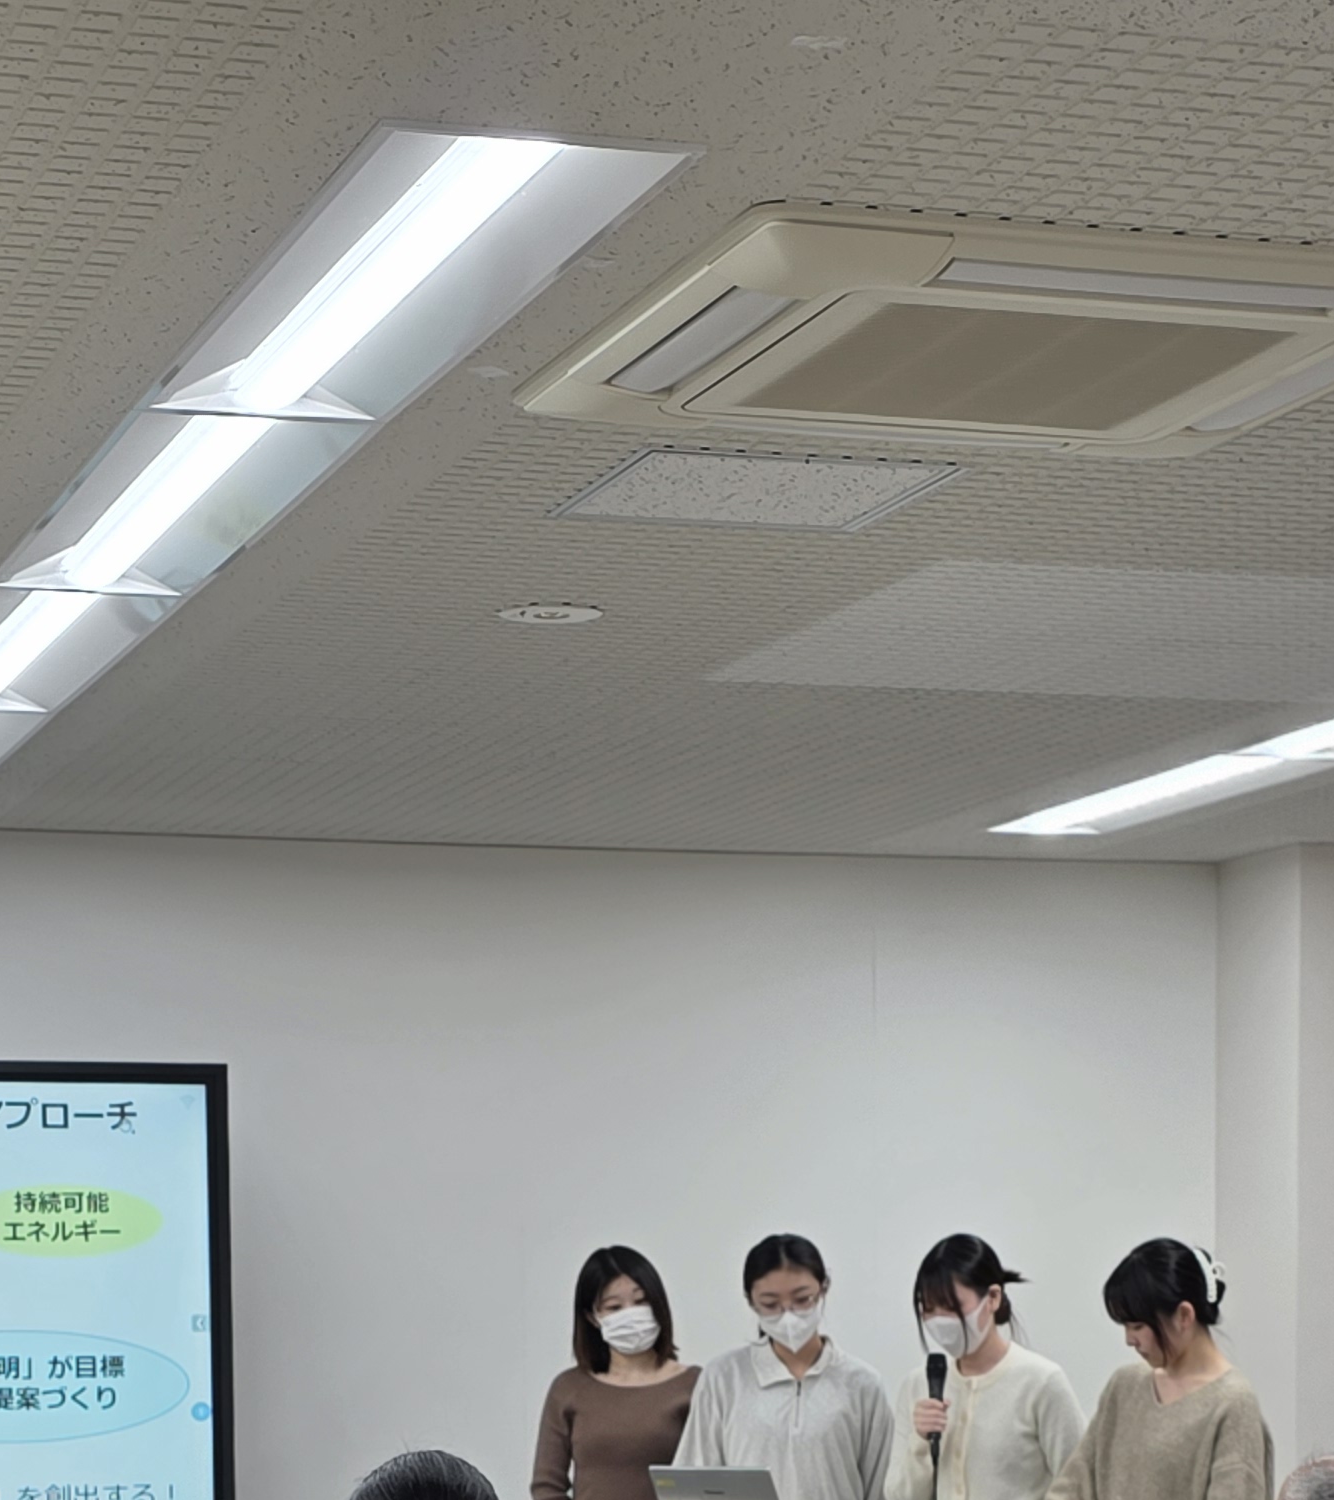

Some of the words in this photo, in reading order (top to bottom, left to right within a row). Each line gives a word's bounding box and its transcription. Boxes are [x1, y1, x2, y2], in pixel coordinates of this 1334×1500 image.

[14, 1191, 110, 1214] 持続可能
[3, 1219, 121, 1242] エネルギー
